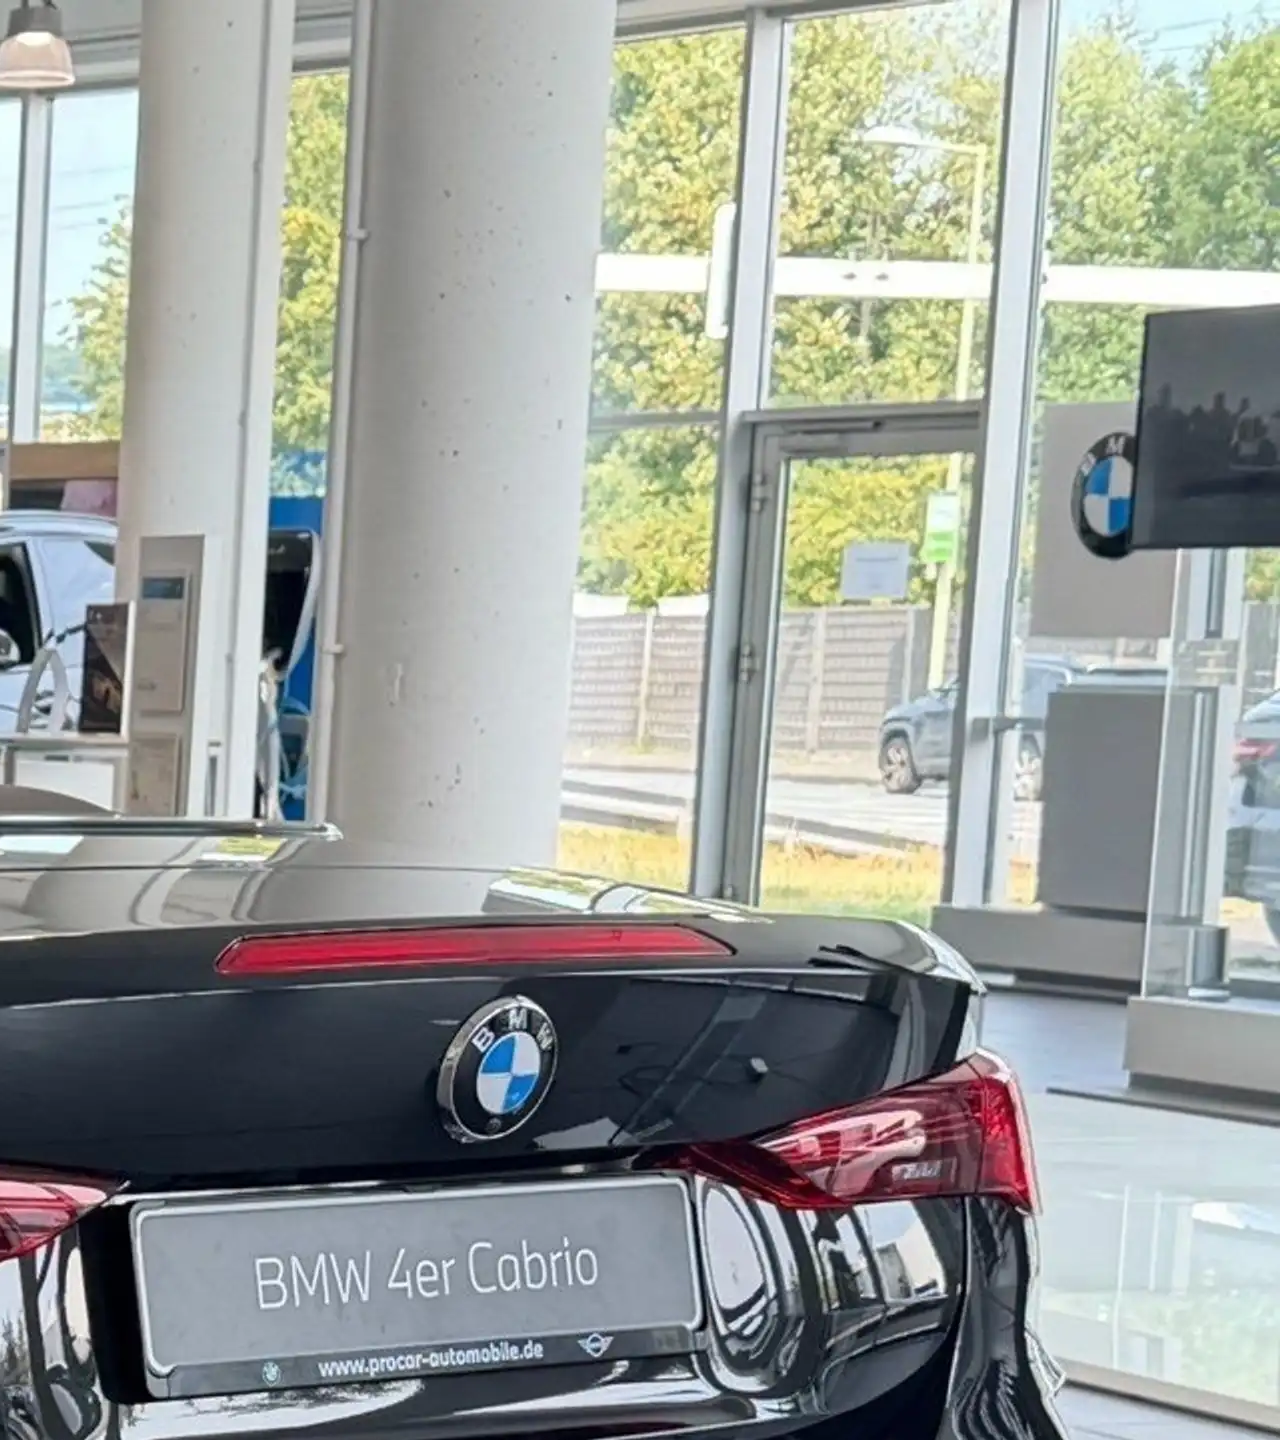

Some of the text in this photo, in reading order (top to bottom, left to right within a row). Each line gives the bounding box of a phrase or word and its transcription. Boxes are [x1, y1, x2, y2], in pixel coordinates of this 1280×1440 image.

[471, 1008, 554, 1053] BMW
[255, 1236, 599, 1309] BMW 4er Cabrio
[318, 1338, 544, 1378] www.procar-automobile.de
